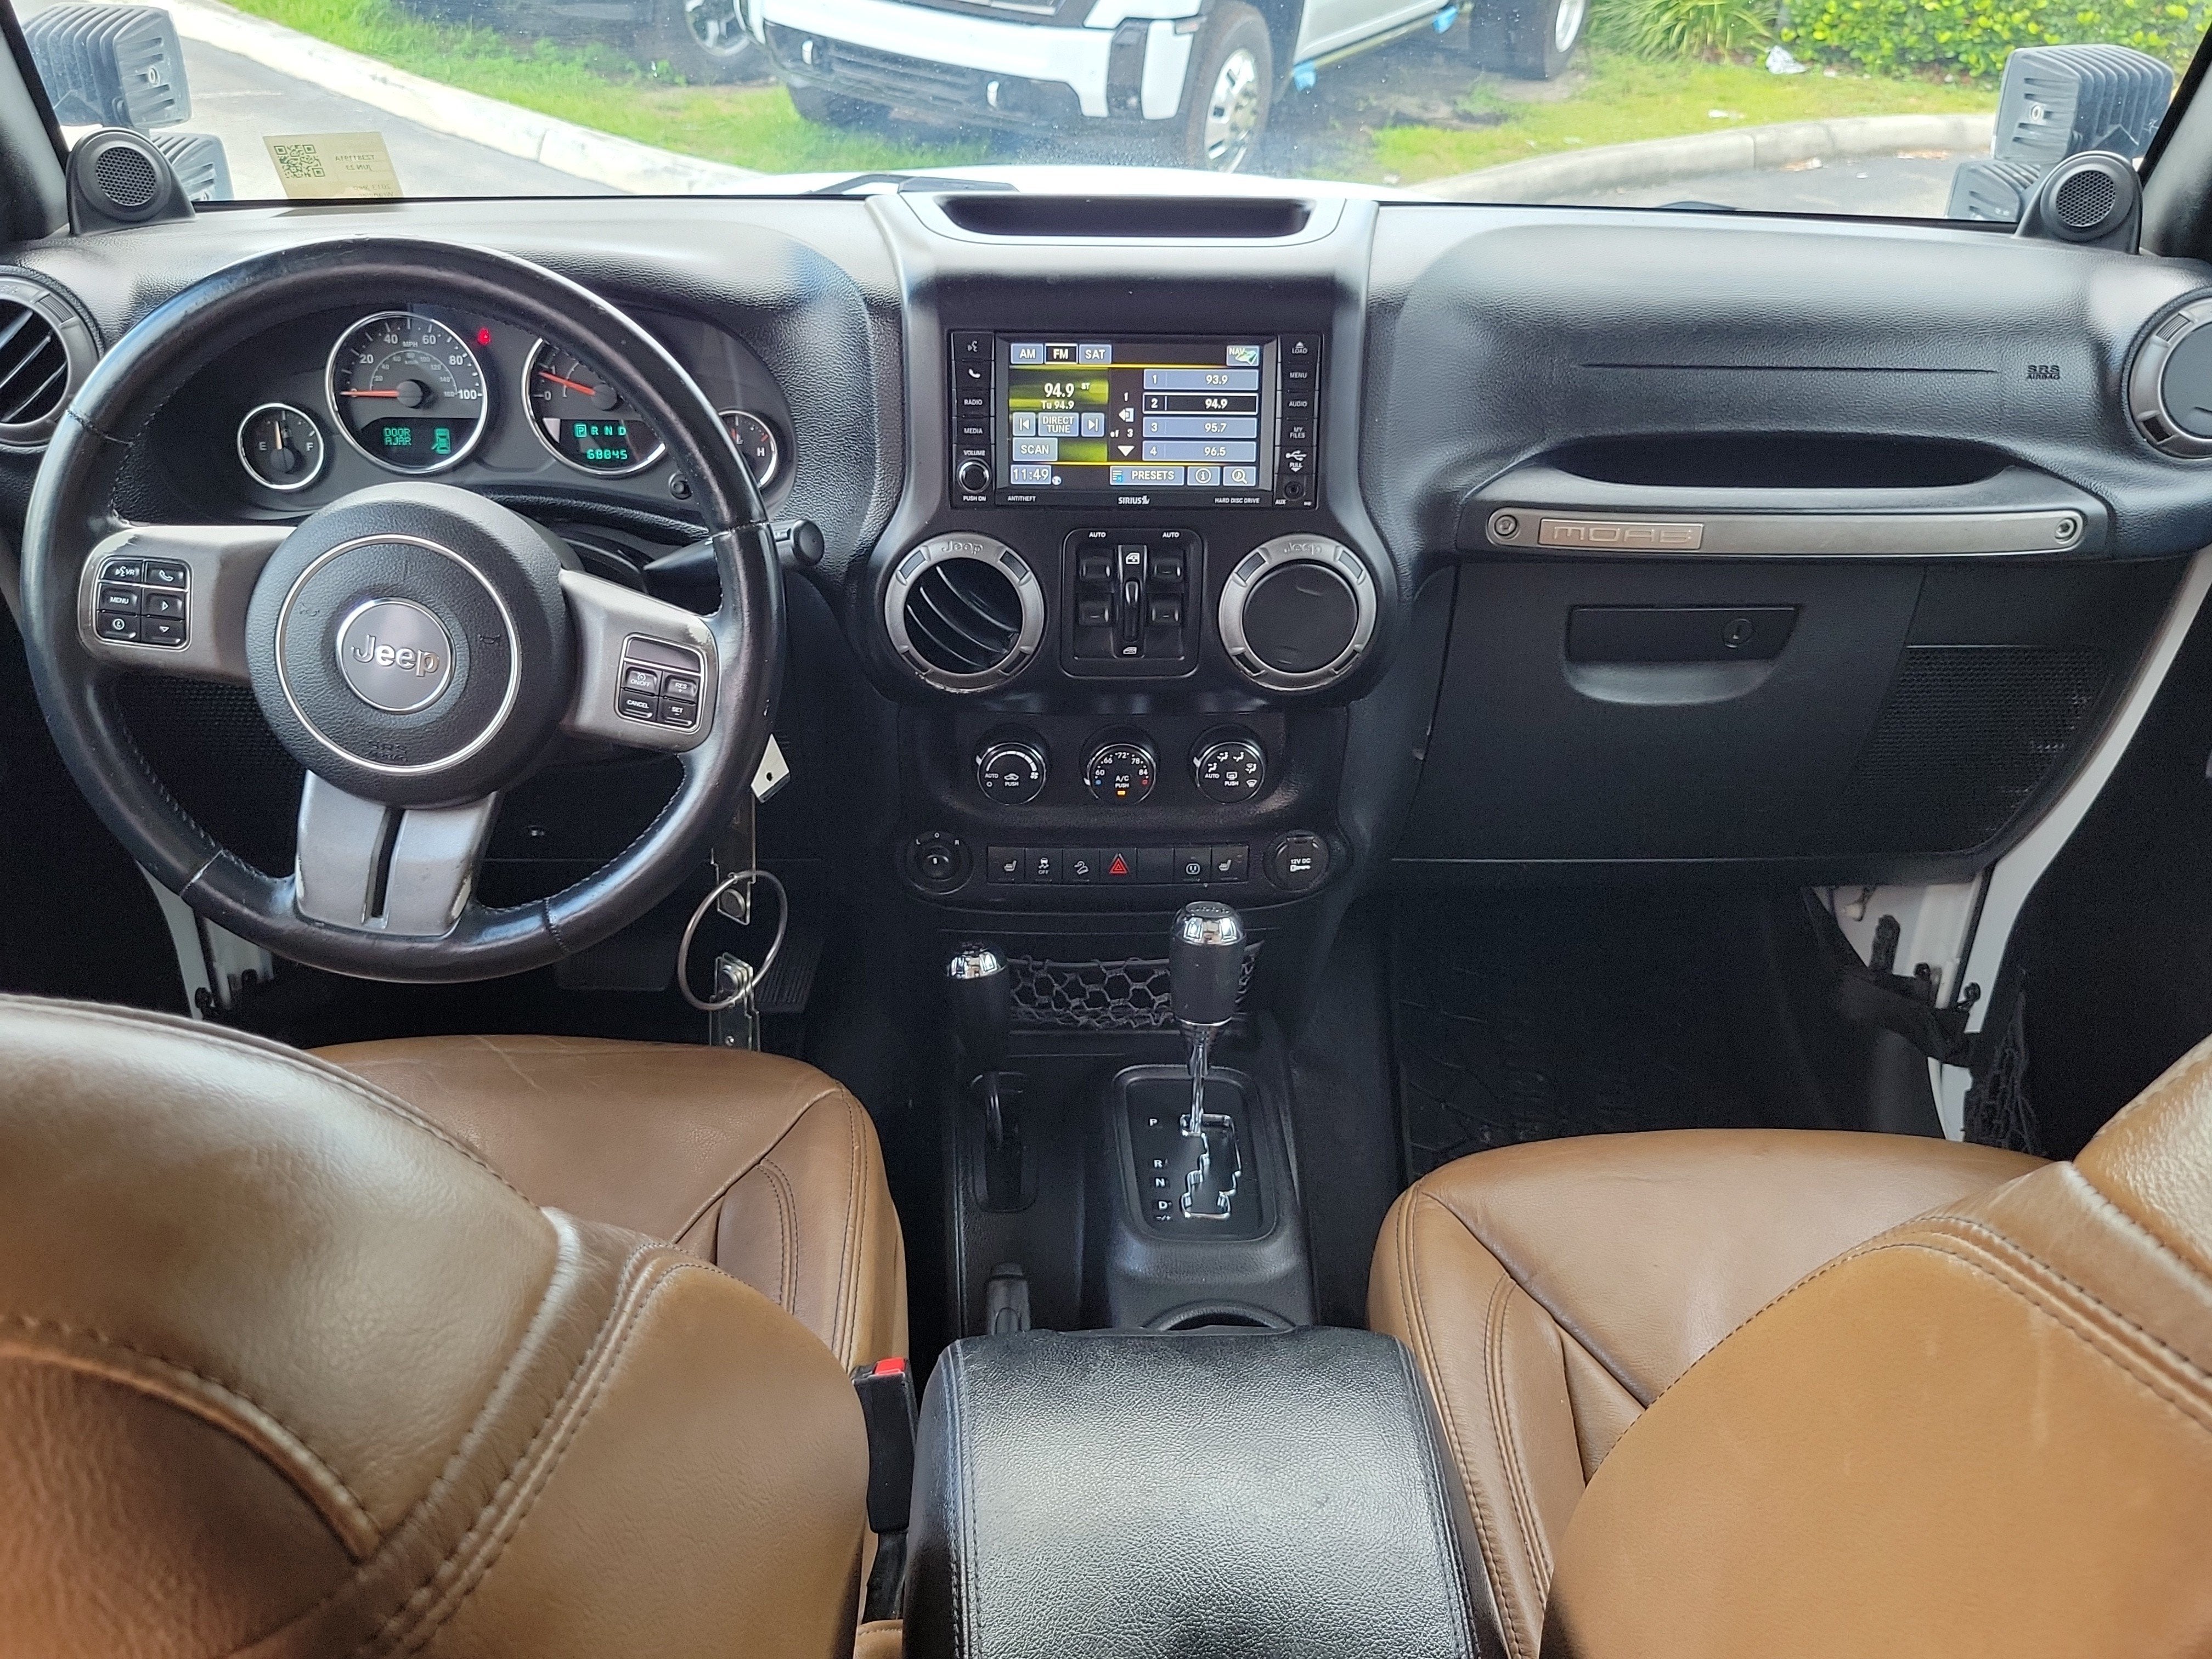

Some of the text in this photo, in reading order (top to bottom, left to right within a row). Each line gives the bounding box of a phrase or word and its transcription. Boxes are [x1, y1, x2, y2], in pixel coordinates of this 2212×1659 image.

[383, 334, 398, 344] 40
[422, 335, 436, 345] 60
[359, 354, 374, 364] 20
[1019, 349, 1036, 359] AM
[1053, 349, 1069, 359] FM
[1085, 349, 1105, 359] SAT
[449, 355, 463, 365] 80
[2027, 365, 2059, 374] SRS
[1152, 375, 1228, 385] 1 93.9
[458, 389, 477, 399] 100
[544, 391, 552, 400] 0
[1044, 383, 1075, 398] 94.9
[1124, 392, 1128, 401] 1
[1041, 400, 1075, 409] Tu 94.9
[1151, 399, 1228, 409] 2 94.9
[1043, 416, 1074, 425] DIRECT
[384, 427, 410, 437] DOOR
[591, 426, 599, 435] R
[604, 426, 613, 435] N
[618, 426, 627, 436] D
[1047, 425, 1070, 433] TUNE
[1127, 428, 1133, 437] 3
[1151, 423, 1227, 433] 3 95.7
[259, 442, 267, 450] E
[385, 437, 411, 445] AJAR
[306, 442, 313, 451] F
[757, 447, 765, 456] H
[1020, 445, 1049, 454] SCAN
[1150, 447, 1226, 456] 4 96.5
[1013, 469, 1049, 481] 11:49
[1131, 470, 1175, 480] PRESETS
[1554, 527, 1692, 543] MOAB
[941, 540, 983, 555] Jeep
[1284, 542, 1322, 555] Jeep
[351, 635, 439, 677] Jeep
[627, 699, 650, 709] CANCEL
[1149, 1118, 1158, 1126] P
[1154, 1159, 1163, 1168] R
[1155, 1178, 1165, 1187] N
[1158, 1200, 1168, 1210] D
